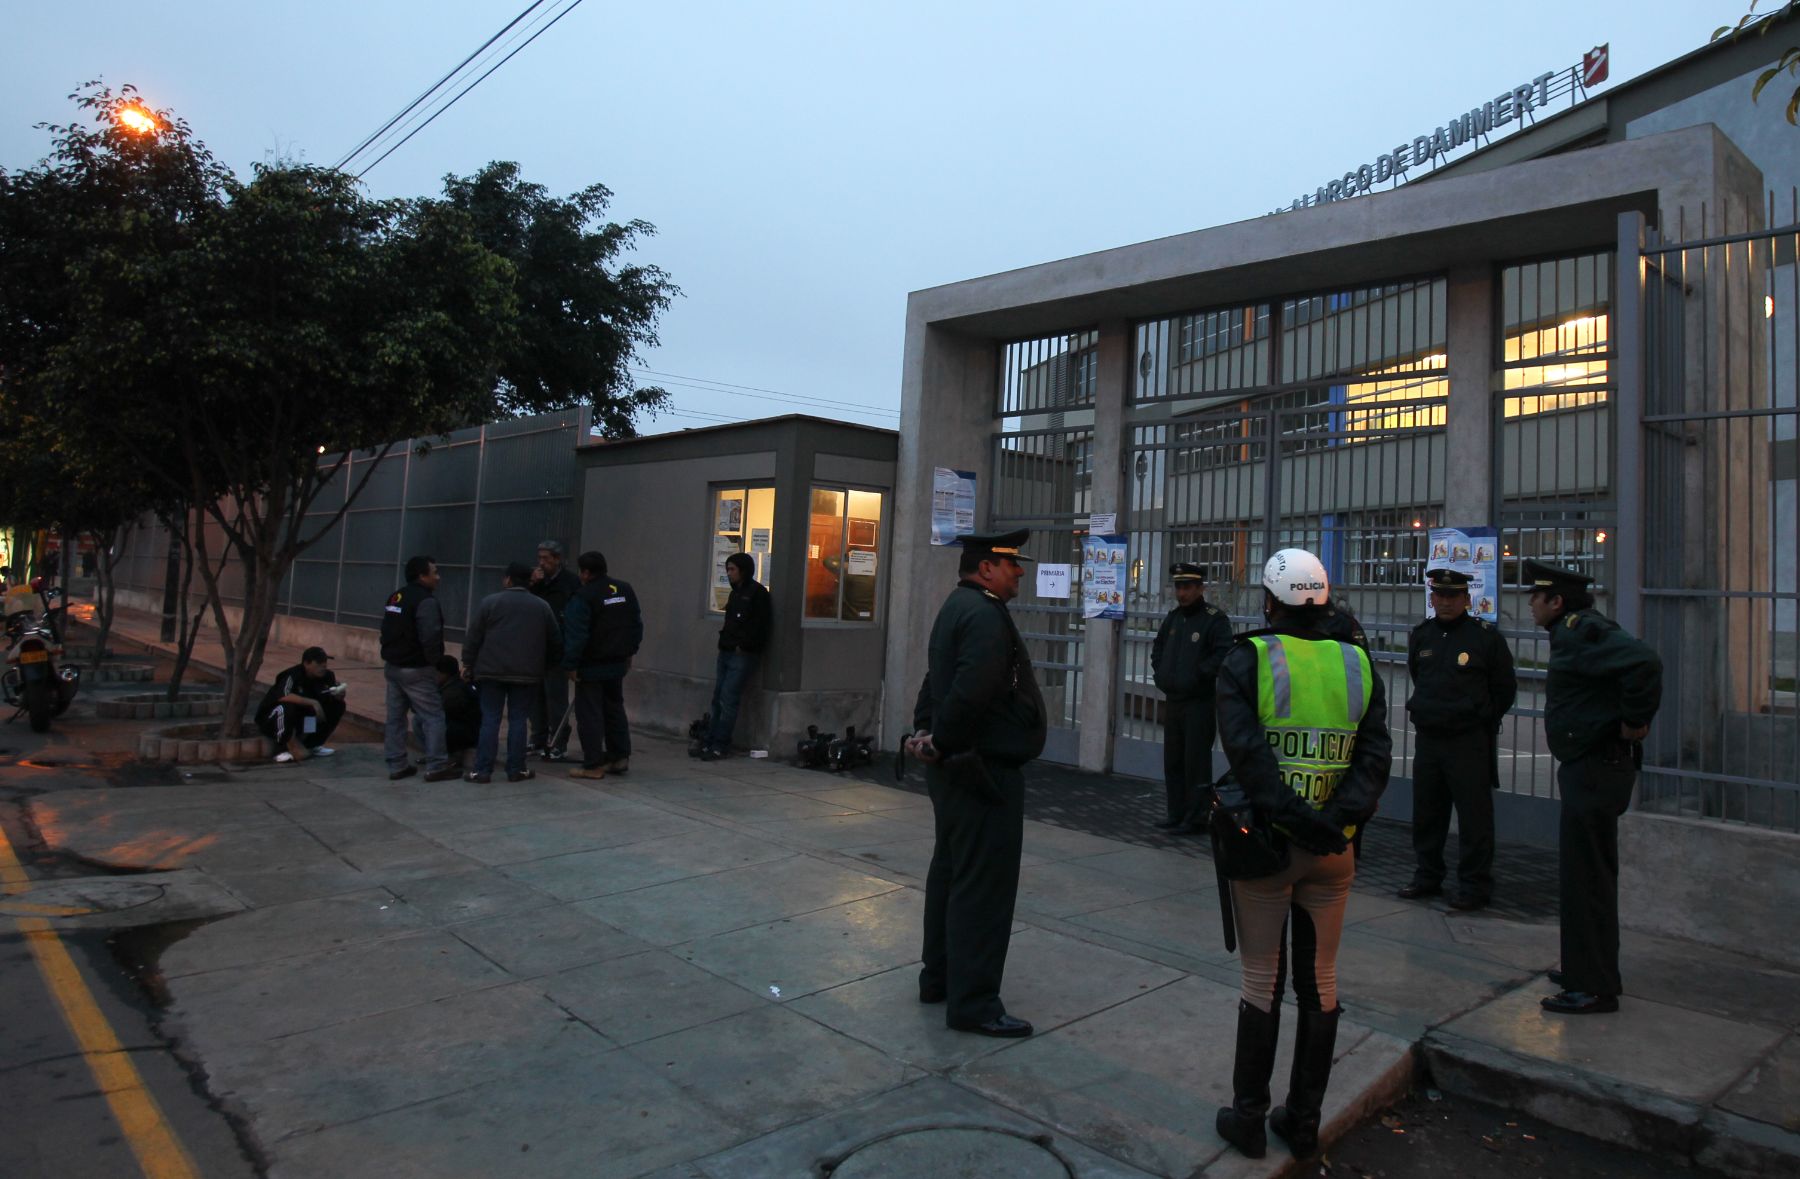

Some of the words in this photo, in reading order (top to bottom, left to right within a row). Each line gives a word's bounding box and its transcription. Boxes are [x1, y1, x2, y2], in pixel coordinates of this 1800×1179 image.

[1376, 143, 1409, 184] DE
[1412, 70, 1554, 167] DAMMERT
[1040, 569, 1065, 577] PRIMARIA
[1290, 581, 1325, 591] POLICIA
[1265, 729, 1358, 762] POLICIA
